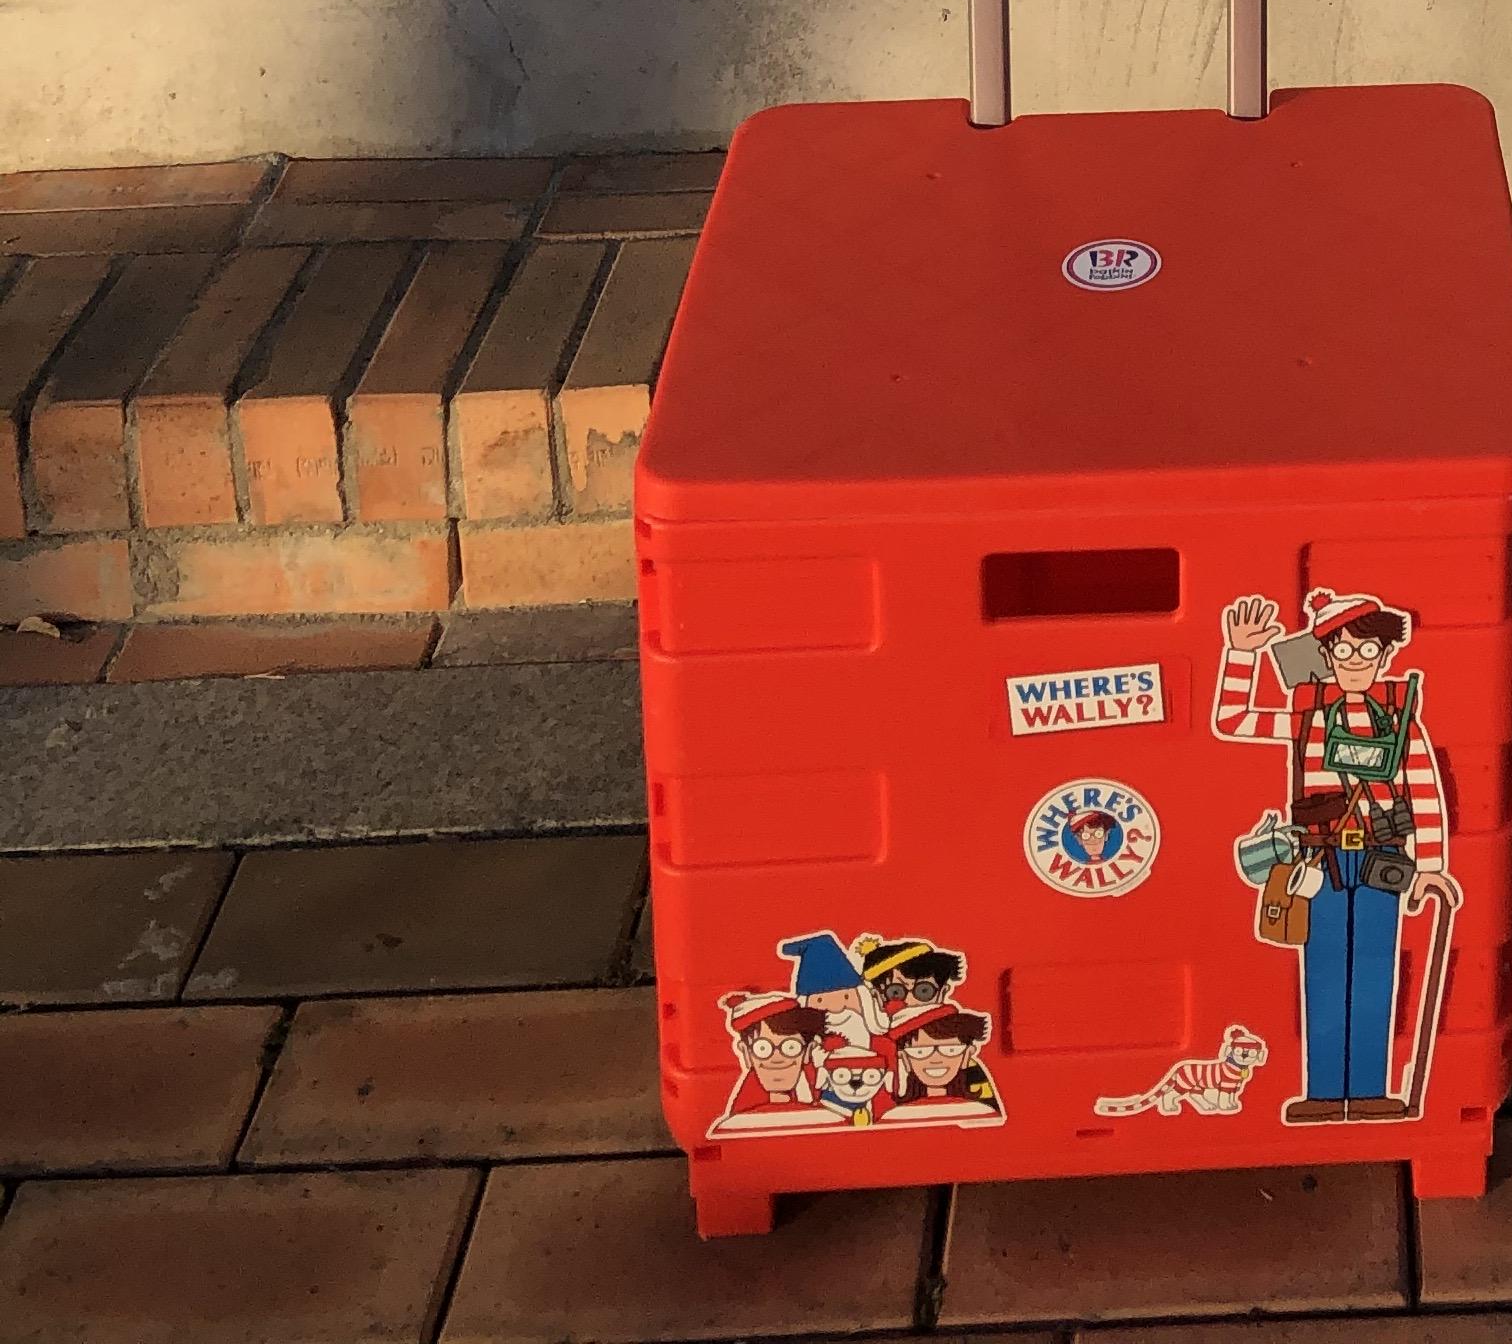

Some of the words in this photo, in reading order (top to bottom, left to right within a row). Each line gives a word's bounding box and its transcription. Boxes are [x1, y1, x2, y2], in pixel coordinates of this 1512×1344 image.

[1089, 249, 1139, 268] BR
[1015, 671, 1154, 704] WHERE'S
[1020, 694, 1154, 728] WALLY?
[1036, 787, 1143, 853] WHERE'S
[1048, 827, 1153, 889] WALLY?
